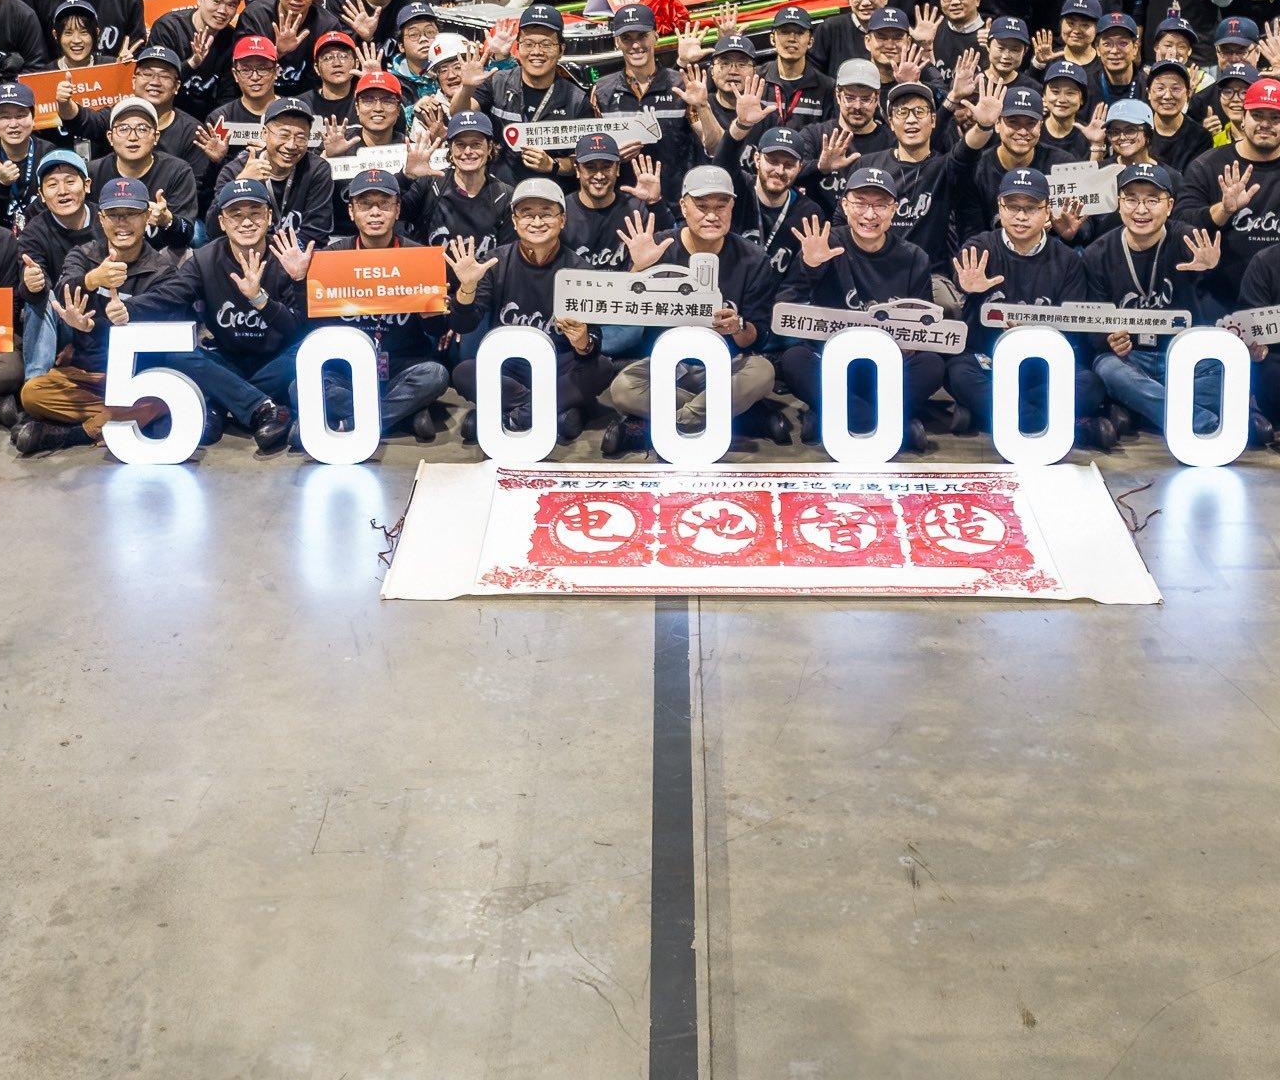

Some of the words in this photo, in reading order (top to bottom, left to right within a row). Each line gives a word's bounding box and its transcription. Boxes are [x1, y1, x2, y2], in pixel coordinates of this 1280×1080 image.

[354, 266, 401, 279] TESLA
[565, 279, 615, 288] TESLA
[315, 288, 324, 299] 5
[326, 286, 373, 299] Million
[376, 284, 439, 297] Batteries
[565, 298, 714, 318] 我们勇于动手解决难题
